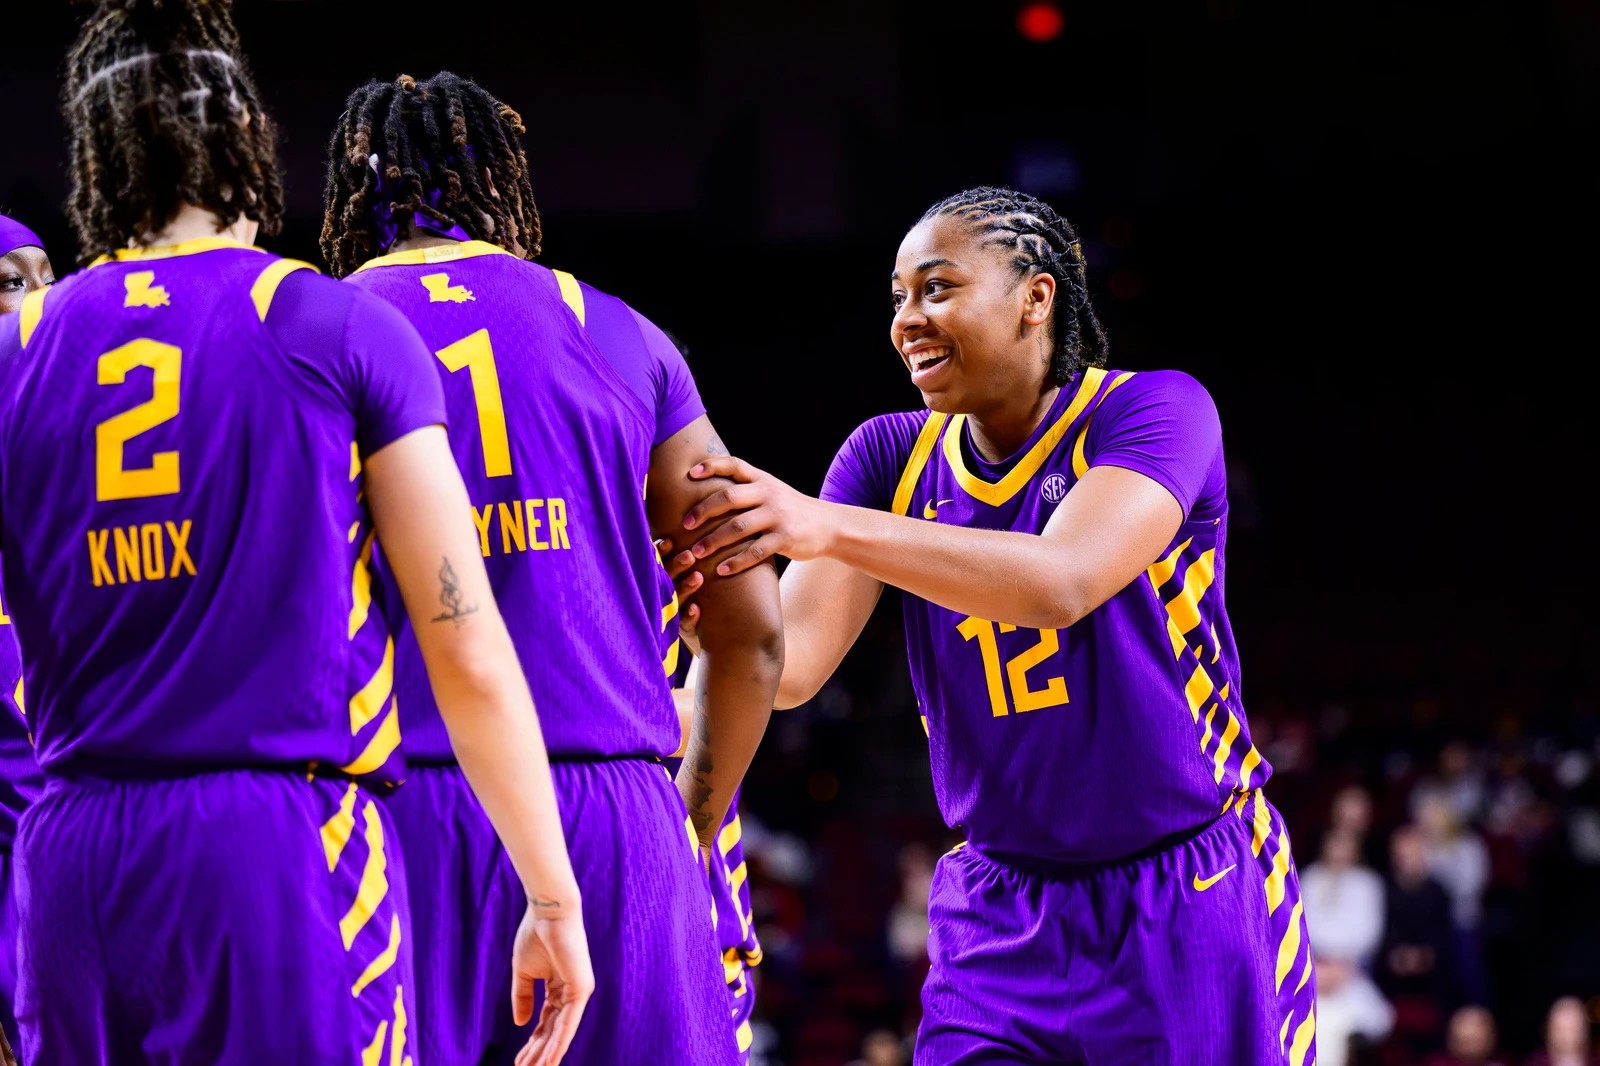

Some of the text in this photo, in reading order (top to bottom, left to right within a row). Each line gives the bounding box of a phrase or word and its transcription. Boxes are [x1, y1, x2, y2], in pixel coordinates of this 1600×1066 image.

[95, 338, 183, 501] 2
[436, 329, 513, 478] 1
[471, 497, 571, 557] YNER
[1043, 476, 1066, 501] SEC
[87, 519, 198, 587] KNOX
[956, 615, 1069, 717] 12
